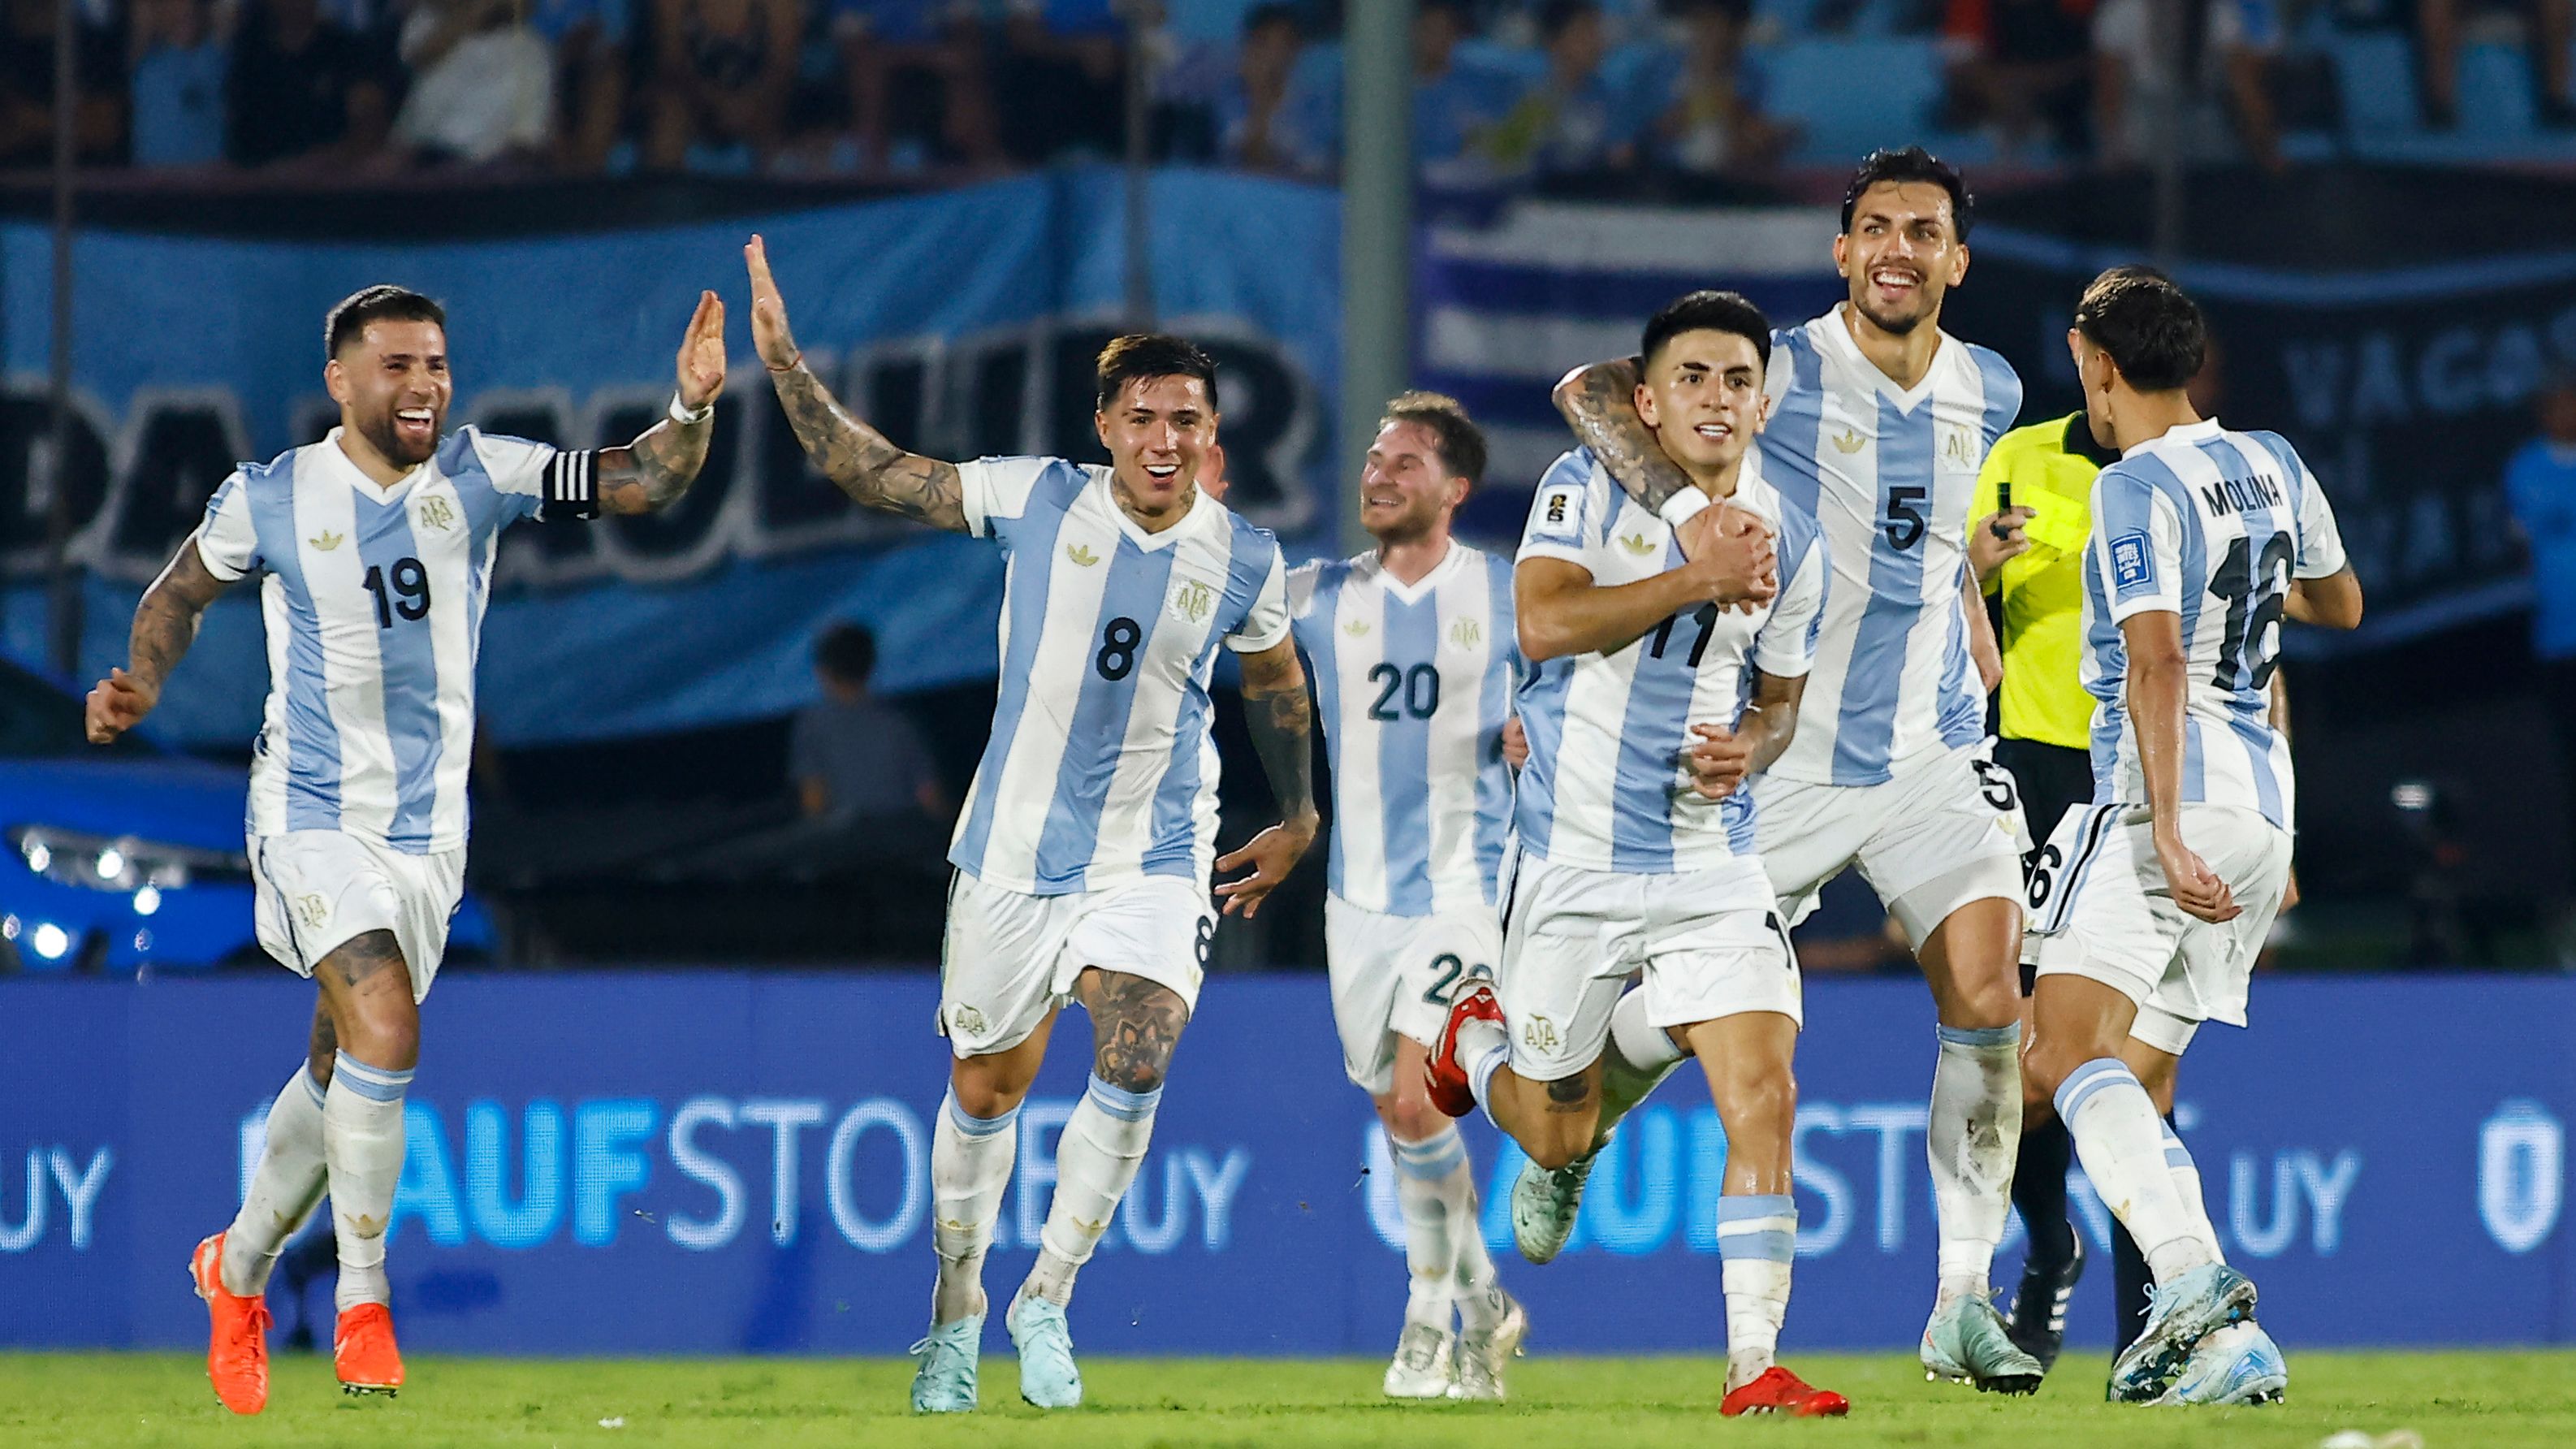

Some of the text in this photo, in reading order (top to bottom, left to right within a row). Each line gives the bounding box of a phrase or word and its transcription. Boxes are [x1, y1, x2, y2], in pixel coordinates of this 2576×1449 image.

[1886, 486, 1926, 551] 5
[2201, 474, 2284, 517] MOLINA
[361, 557, 431, 629] 19
[1096, 616, 1141, 681] 8
[1649, 601, 1719, 668] 11
[1368, 662, 1439, 721] 20
[1971, 759, 2015, 811] 5
[1194, 915, 1213, 968] 8
[1422, 952, 1493, 1007] 2
